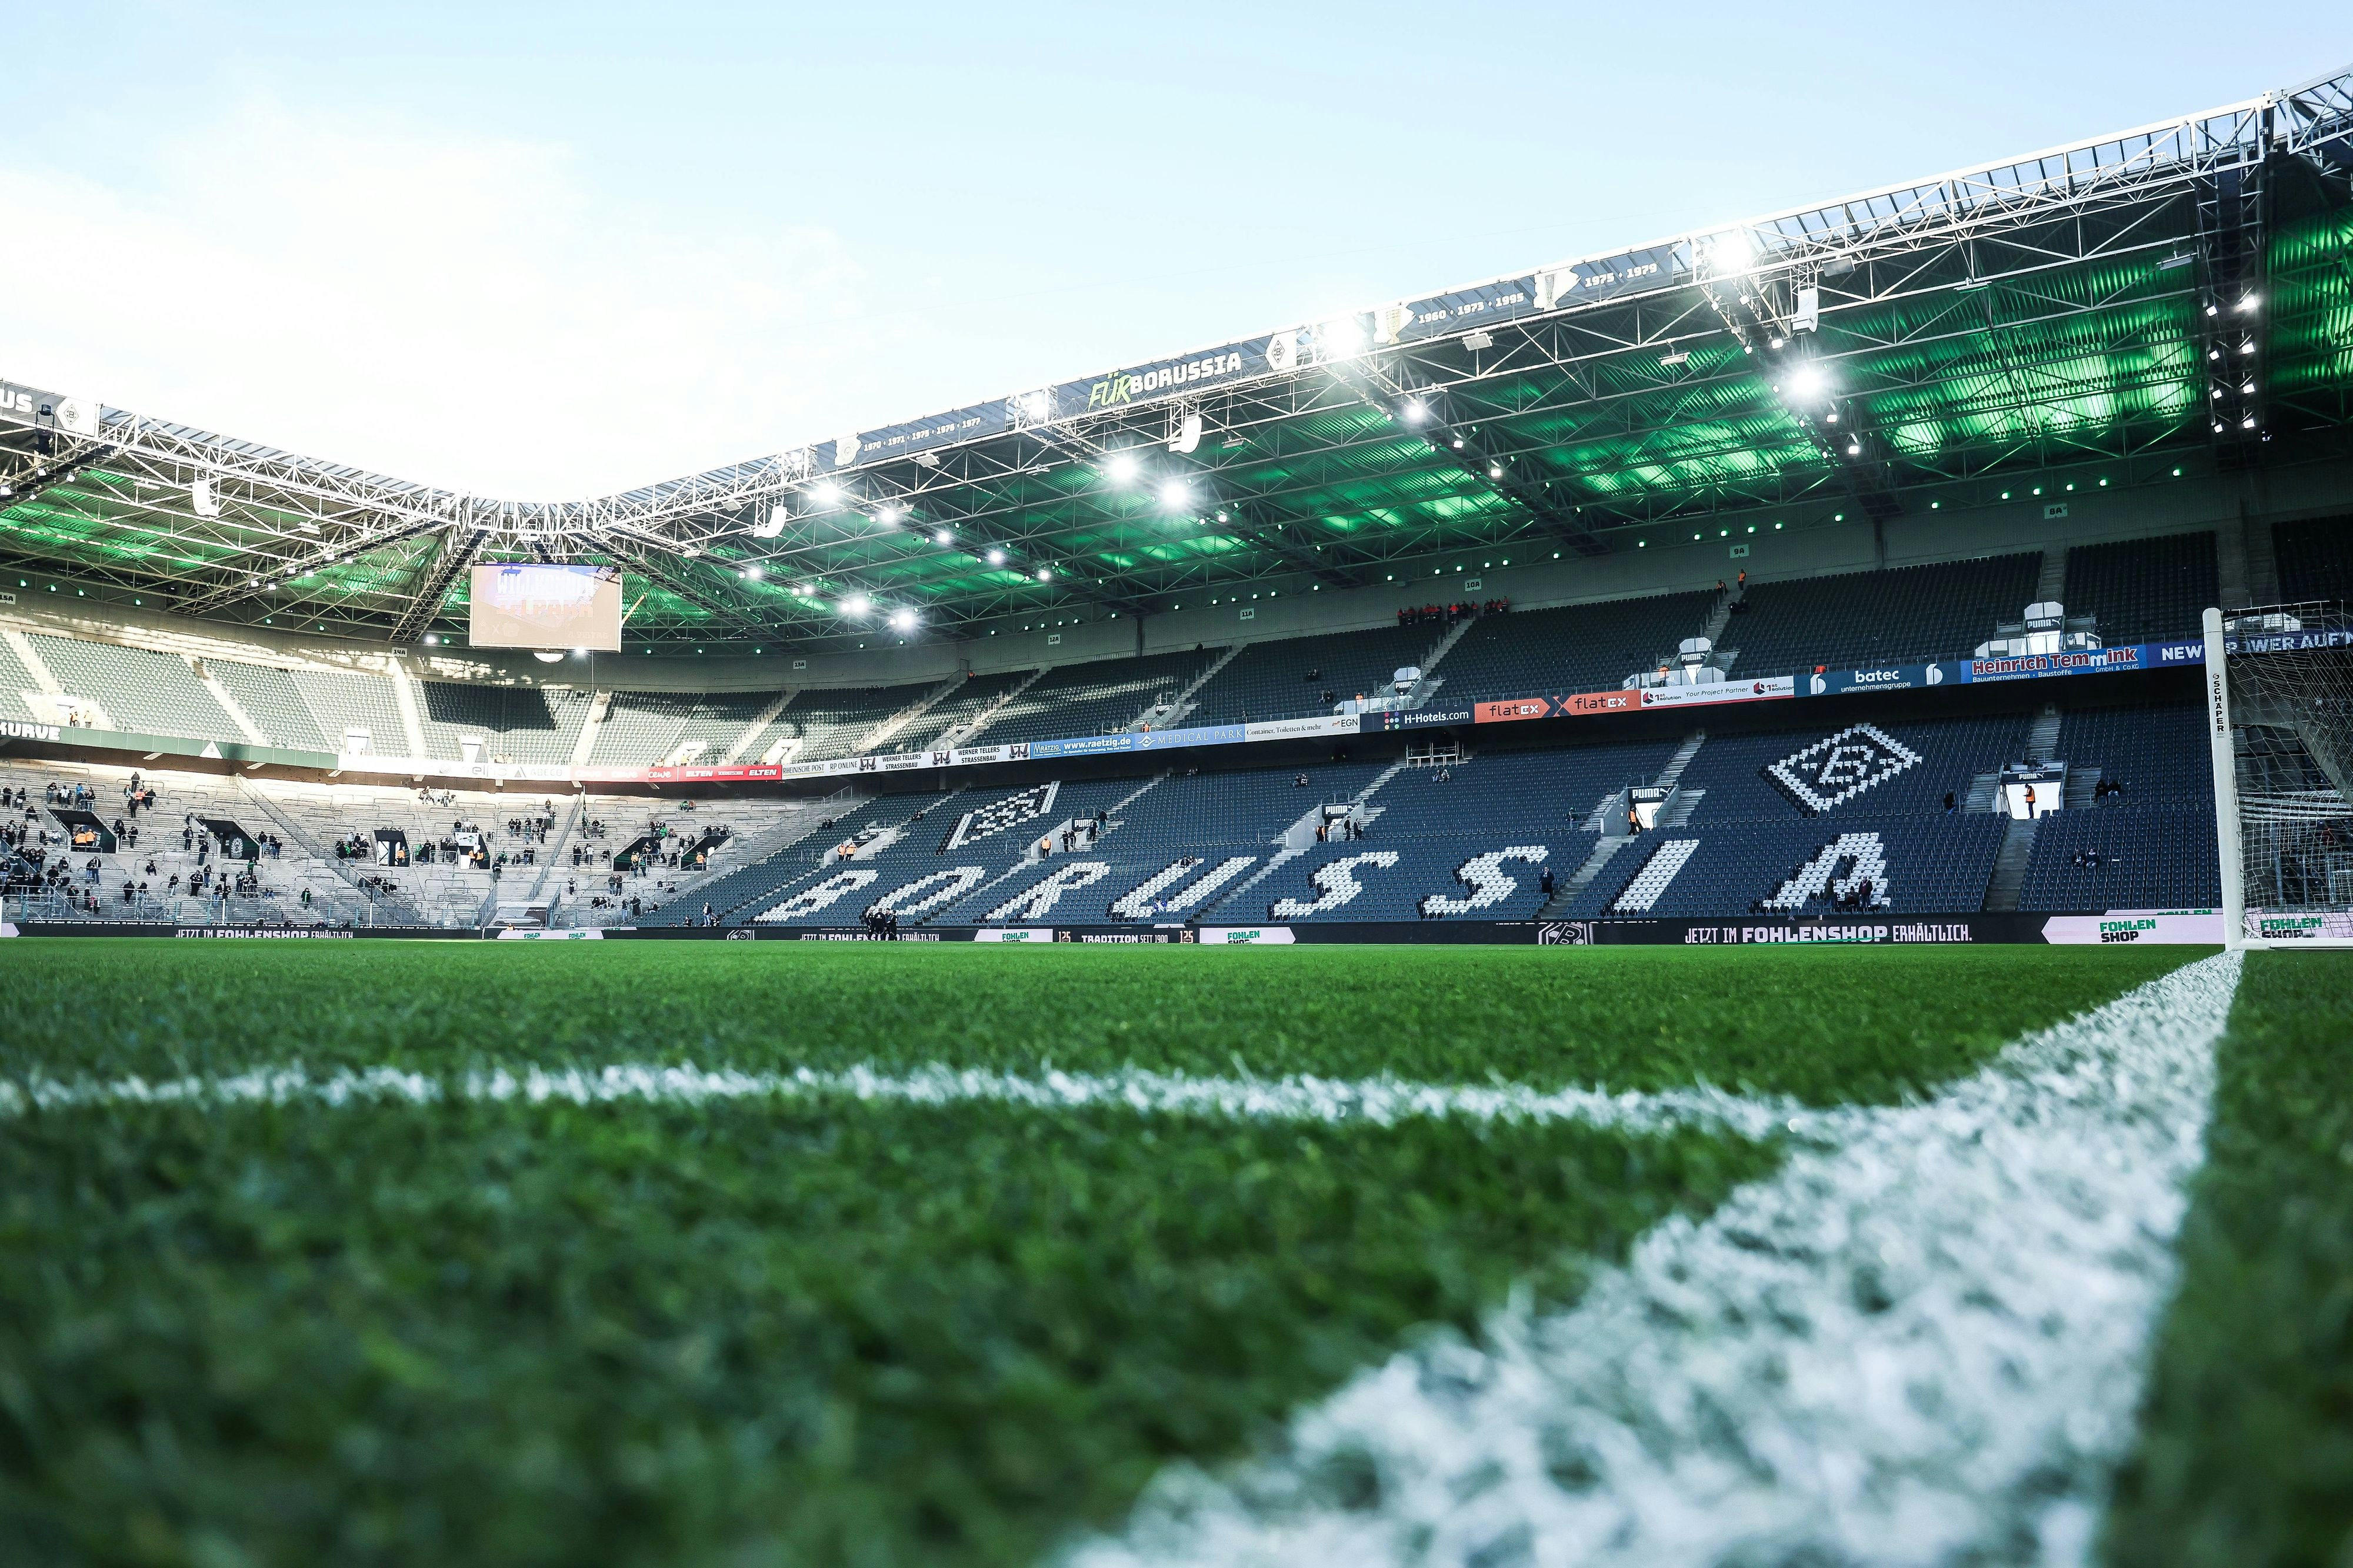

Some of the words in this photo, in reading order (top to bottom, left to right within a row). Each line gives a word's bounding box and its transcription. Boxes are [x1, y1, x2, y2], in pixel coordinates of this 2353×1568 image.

[1585, 272, 1615, 288] 1975
[1627, 262, 1658, 279] 1979
[1418, 309, 1447, 325] 1960
[1457, 301, 1485, 316] 1973
[1495, 292, 1524, 308] 1995
[1088, 372, 1132, 412] FÜR
[1130, 352, 1241, 395] BORUSSIA
[864, 440, 881, 452] 1970
[888, 435, 905, 446] 1971
[962, 416, 981, 429] 1977
[2027, 619, 2051, 628] PUMA
[1681, 653, 1701, 661] PUMA
[2161, 645, 2201, 660] NEW
[1972, 656, 2047, 675] Heinrich
[2050, 648, 2139, 669] Temmink
[1855, 669, 1899, 683] batec
[1972, 673, 2029, 683] Bauunternehmen
[2038, 669, 2072, 678] Baustoffe
[1841, 681, 1911, 693] unternehmensgruppe
[2214, 680, 2224, 732] SCHÄPER
[1341, 718, 1358, 727] EGN
[1404, 710, 1469, 725] H-Hotels.com
[1158, 733, 1208, 745] MEDICAL
[1215, 729, 1242, 739] PARK
[1064, 737, 1131, 750] www.raetzig.de
[979, 746, 1000, 755] TELLERS
[838, 761, 858, 769] ONLINE
[961, 755, 996, 763] STRASSENBAU
[784, 766, 810, 774] RHEINISCHE
[885, 762, 918, 770] STRASSENBAU
[648, 770, 672, 779] cewe
[1632, 788, 1659, 799] PUMA
[2099, 919, 2156, 933] FOHLEN
[1002, 932, 1029, 940] FOHLEN
[1082, 935, 1138, 943] TRADITION
[1140, 935, 1153, 943] SEIT
[1155, 935, 1168, 943] 1900
[1179, 930, 1194, 943] 125
[1228, 930, 1260, 940] FOHLEN
[1685, 928, 1718, 943] JETZT
[1722, 928, 1737, 943] IM
[1742, 926, 1888, 943] FOHLENSHOP
[2101, 931, 2139, 943] SHOP
